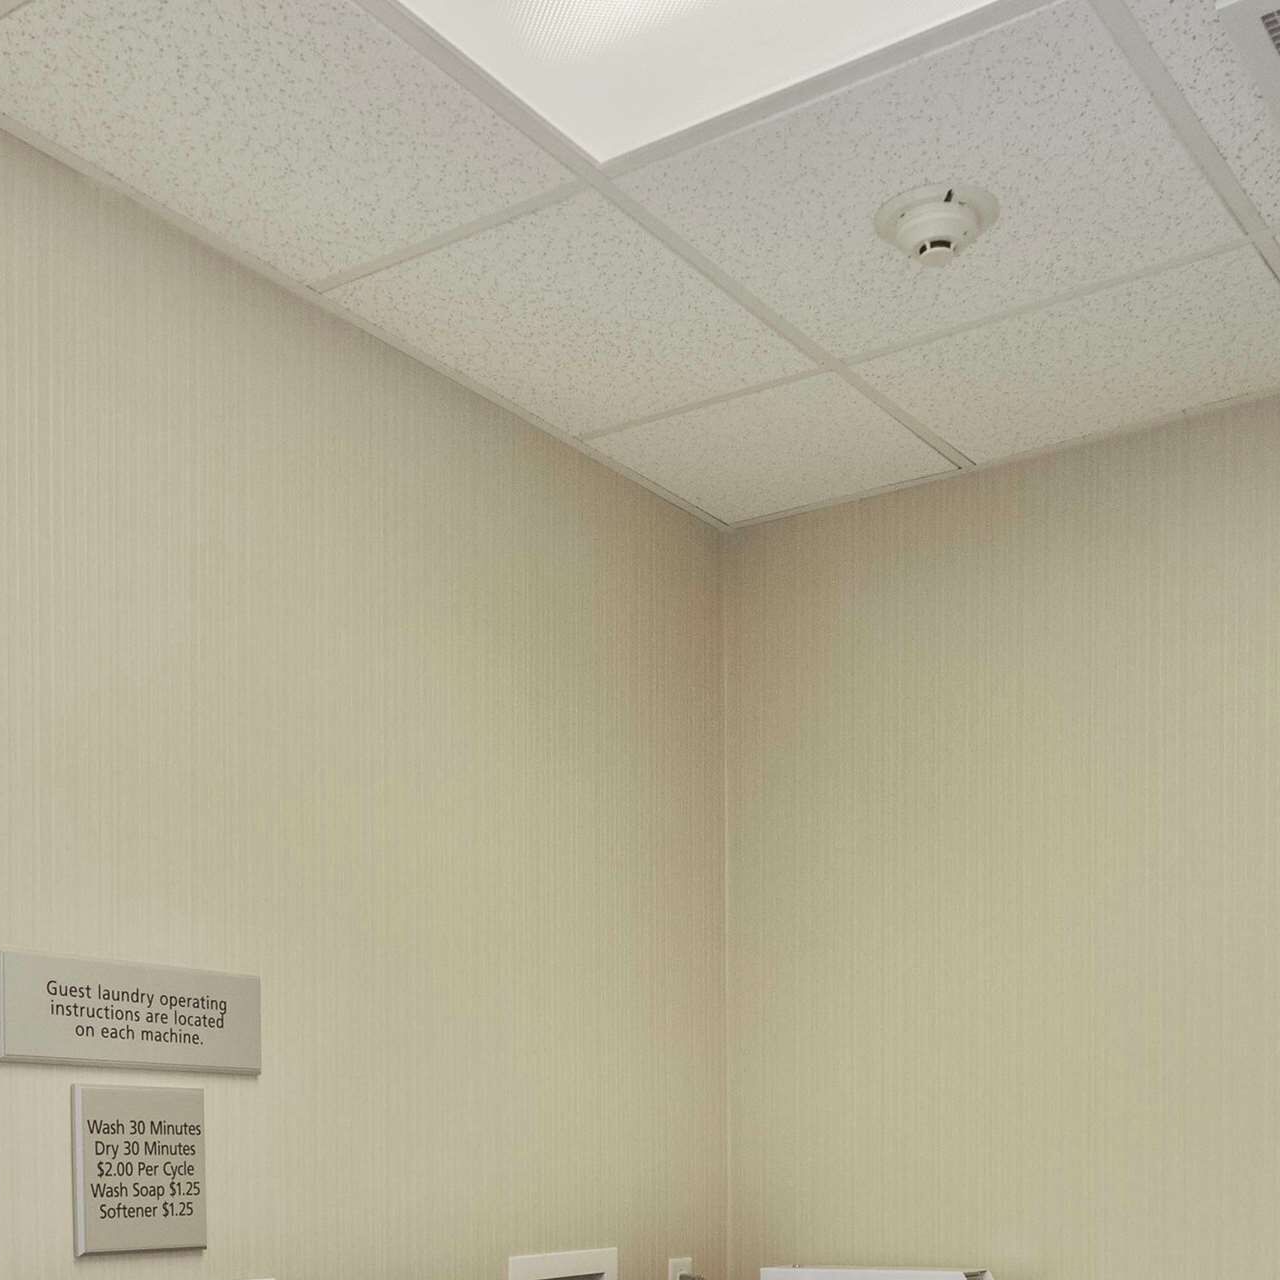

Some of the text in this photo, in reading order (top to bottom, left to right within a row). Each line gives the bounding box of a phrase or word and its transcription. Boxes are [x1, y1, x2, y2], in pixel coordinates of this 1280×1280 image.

[46, 979, 228, 1015] Guest laundry operating
[50, 1000, 224, 1029] instructions are located
[75, 1023, 204, 1045] on each machine.
[87, 1119, 202, 1136] Wash 30 Minutes
[95, 1141, 196, 1159] Dry 30 Minutes
[97, 1161, 195, 1179] $2.00 Per Cycle
[90, 1181, 201, 1201] Wash Soap $1.25
[99, 1201, 194, 1219] Softener $1.25
